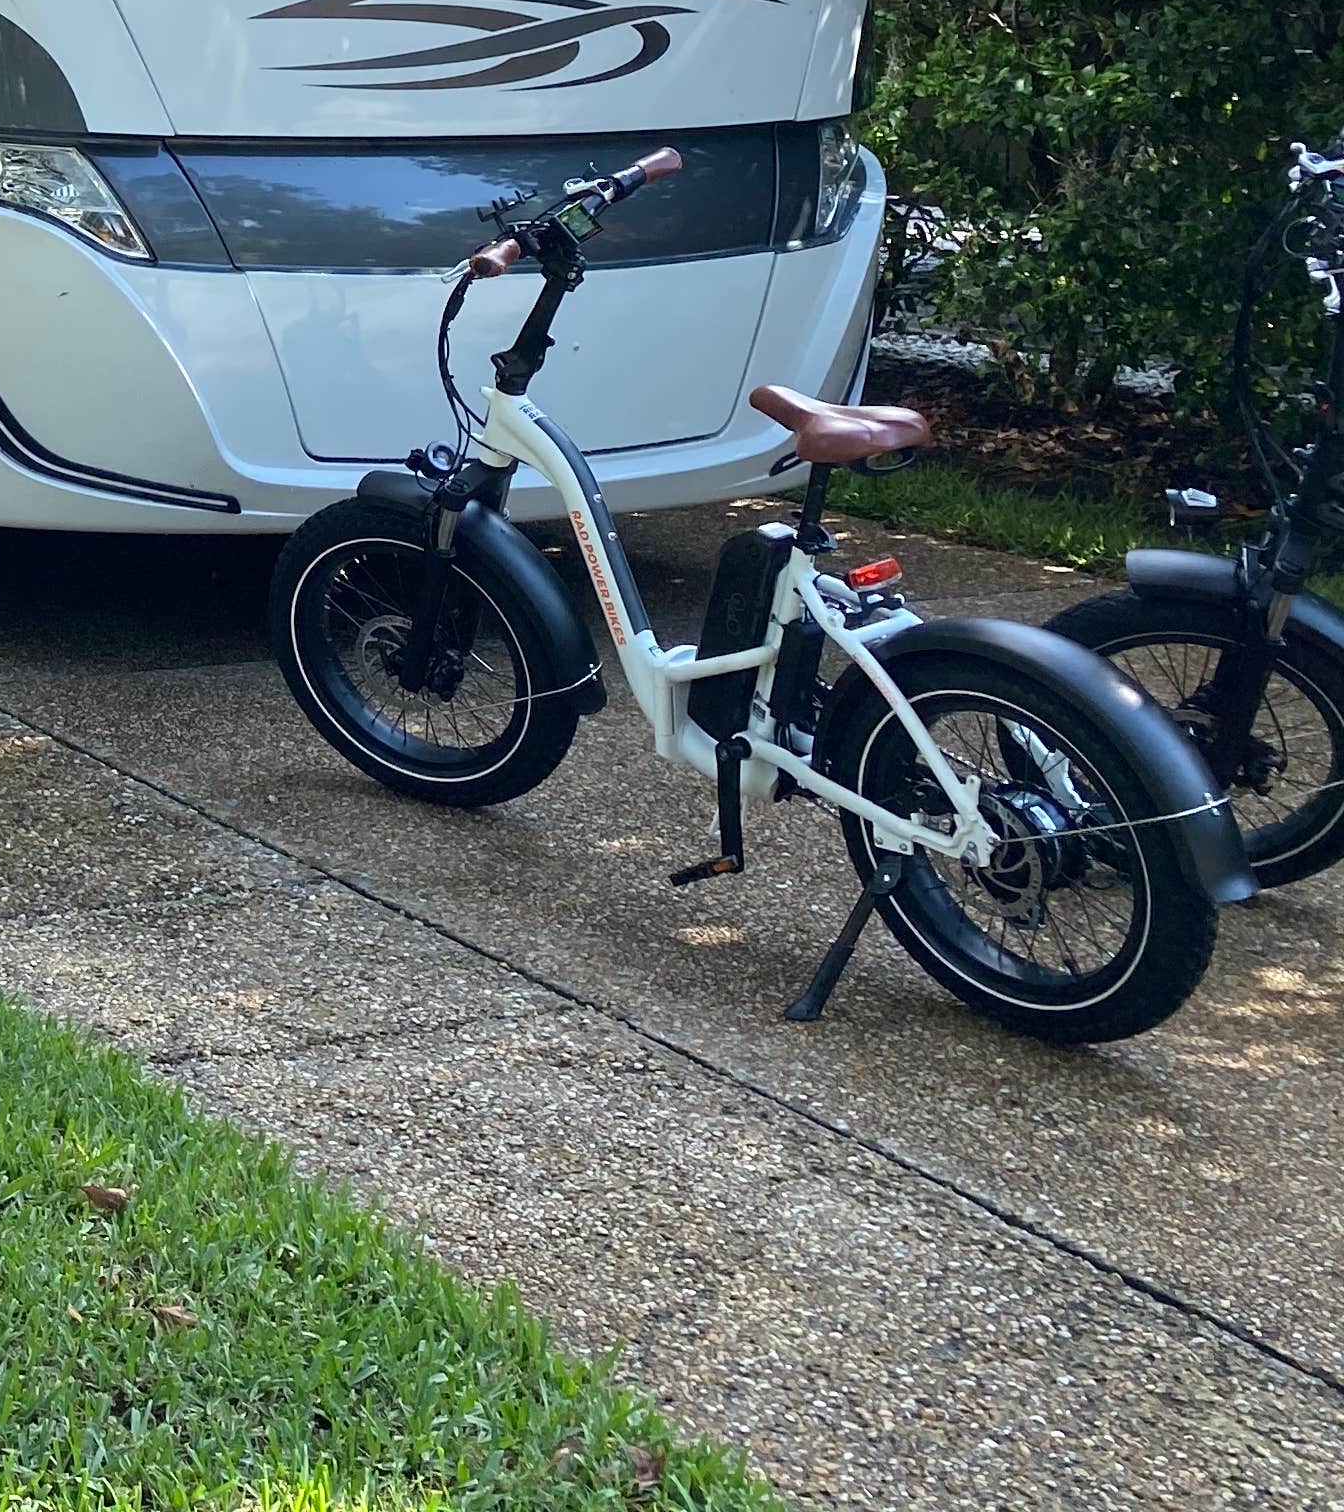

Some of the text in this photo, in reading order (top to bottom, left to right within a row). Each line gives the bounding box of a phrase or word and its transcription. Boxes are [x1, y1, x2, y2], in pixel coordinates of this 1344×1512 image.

[570, 510, 627, 646] RAD POWER BIKES
